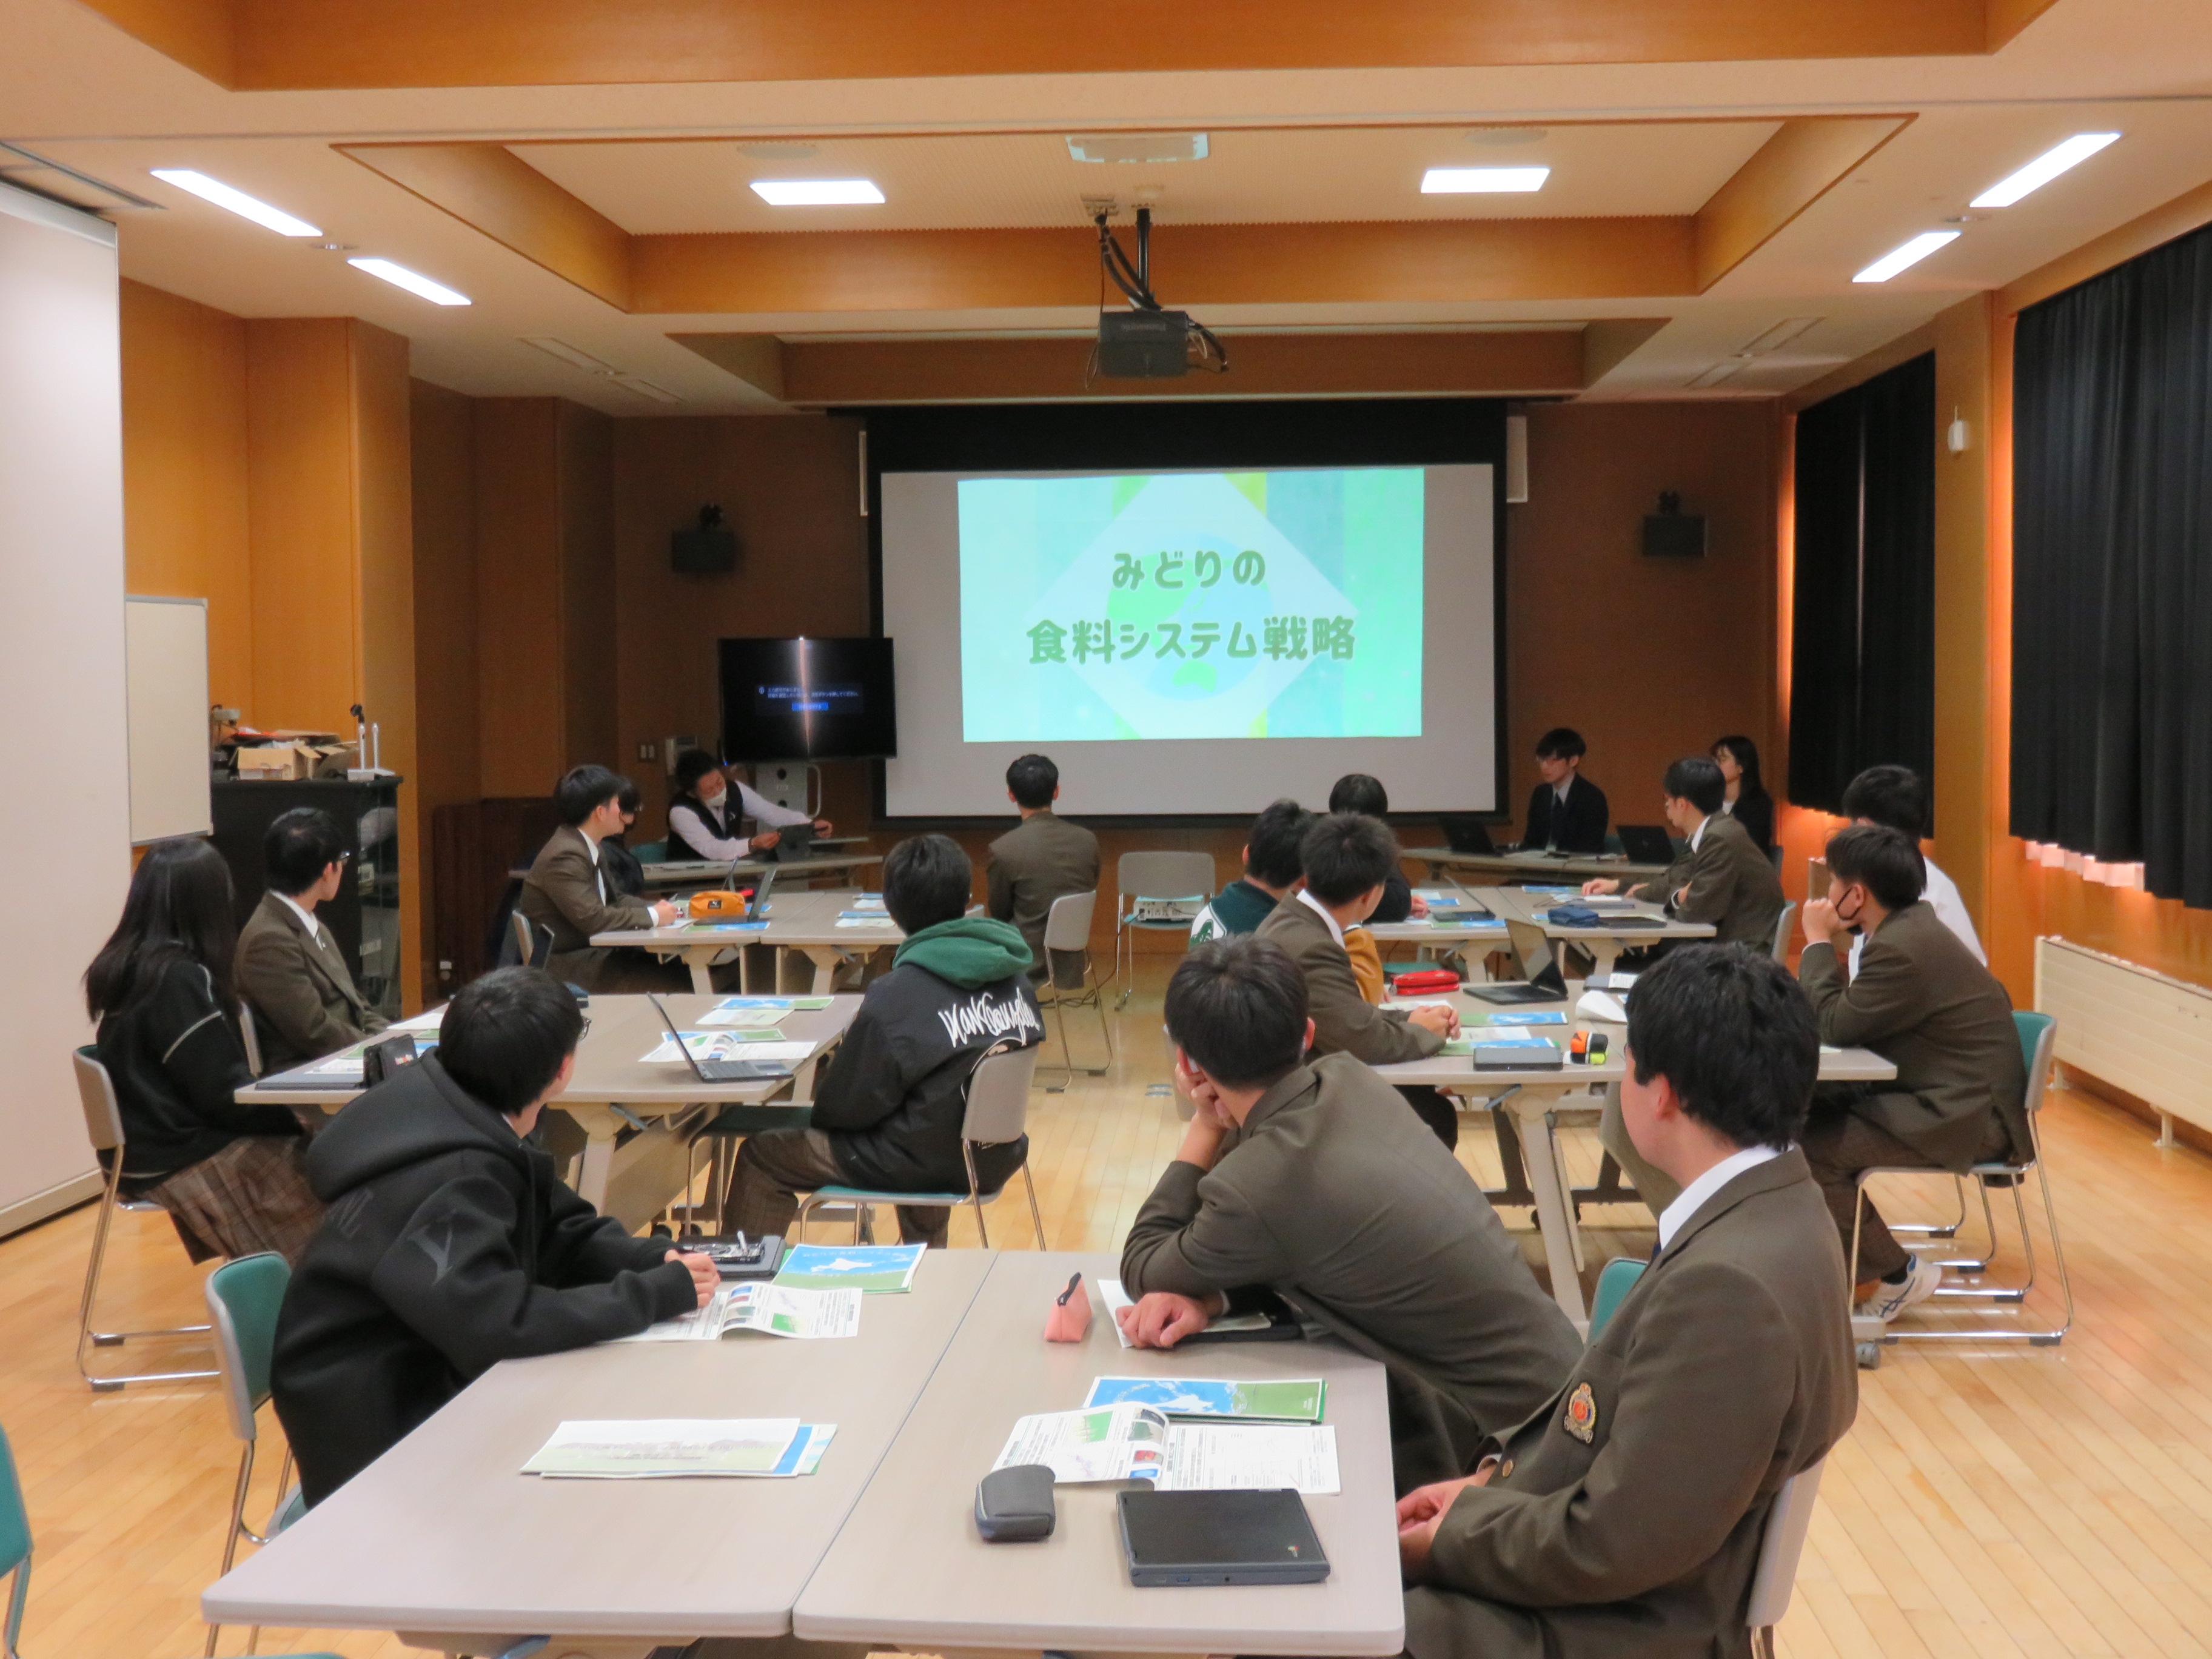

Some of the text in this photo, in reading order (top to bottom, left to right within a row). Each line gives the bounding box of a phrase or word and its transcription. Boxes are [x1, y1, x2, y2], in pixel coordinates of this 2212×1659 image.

[1112, 551, 1265, 590] みどりの
[1026, 617, 1355, 664] 食料システム戦略
